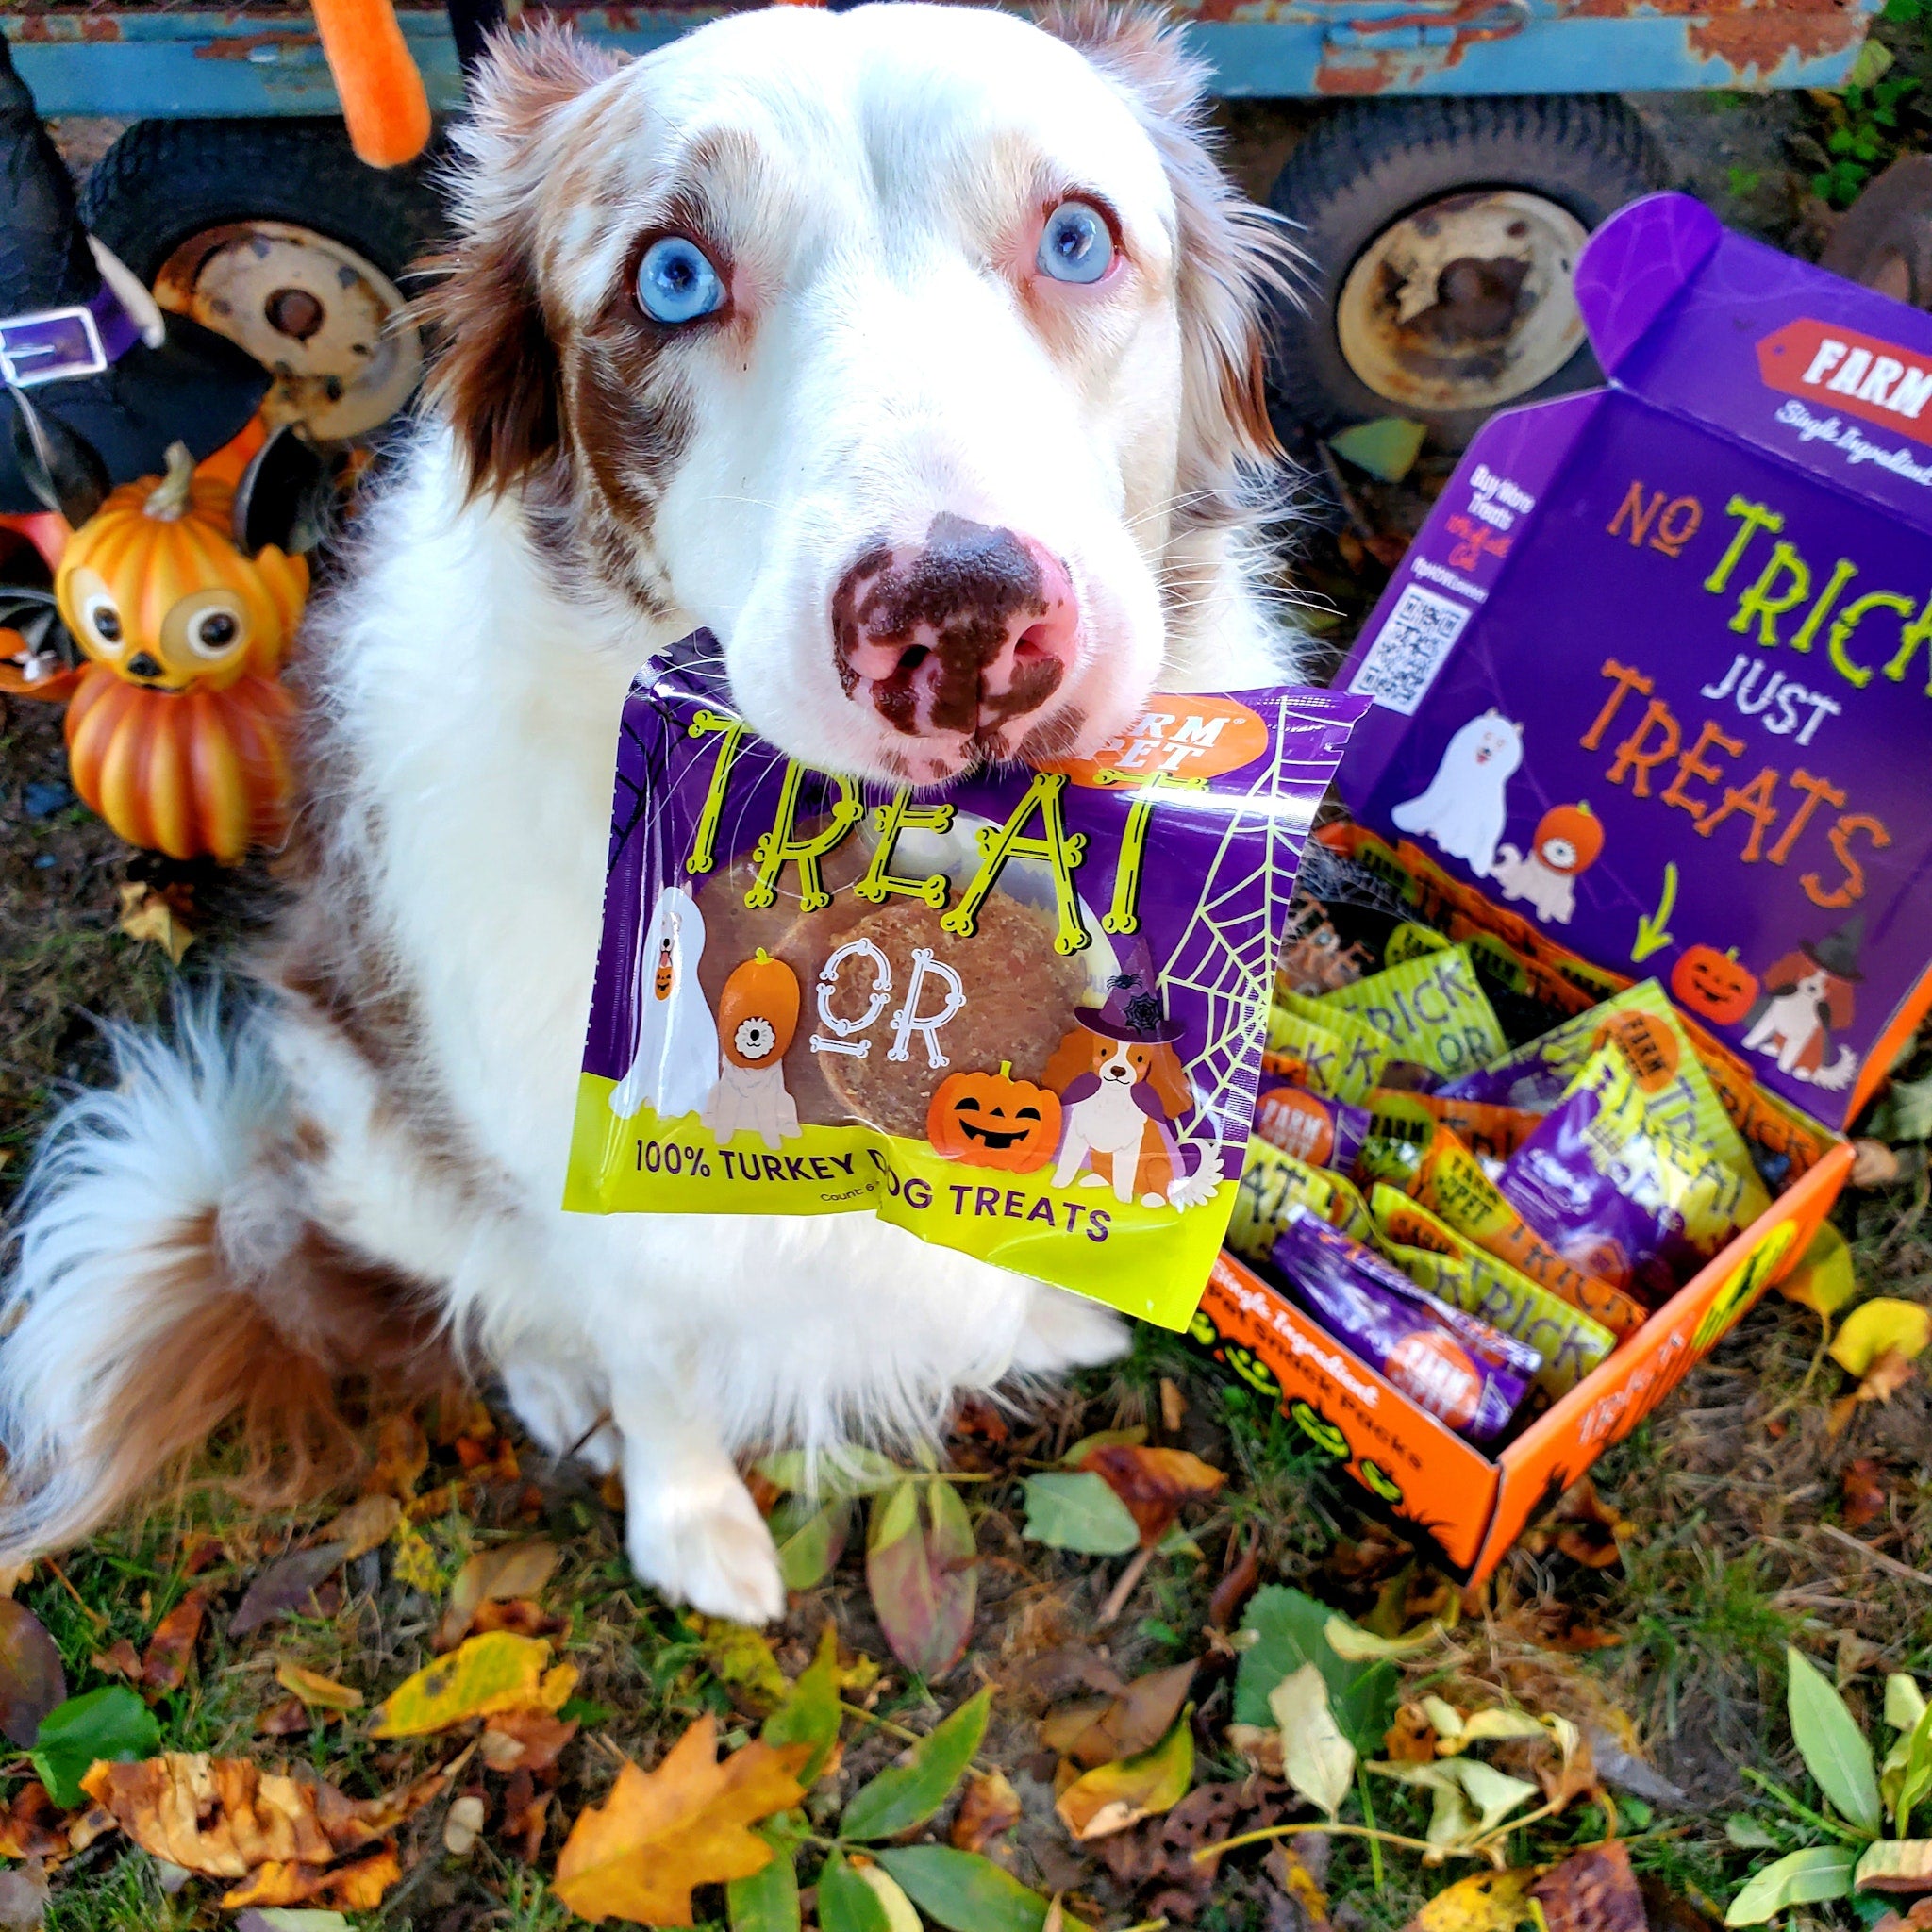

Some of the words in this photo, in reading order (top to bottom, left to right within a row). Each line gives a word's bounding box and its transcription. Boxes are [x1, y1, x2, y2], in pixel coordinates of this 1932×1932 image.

[1771, 399, 1841, 442] Single
[1801, 338, 1932, 419] FARM
[1469, 463, 1502, 501] Buy
[1606, 480, 1703, 558] NO
[1129, 712, 1231, 748] RM
[1701, 654, 1842, 747] JUST
[1579, 658, 1892, 908] TREATS
[687, 708, 1211, 957] TREAT
[809, 937, 967, 1069] OR
[1343, 959, 1478, 1045] RICK
[1436, 1026, 1496, 1072] OR
[636, 1139, 711, 1178] 100%
[718, 1148, 855, 1182] TURKEY
[949, 1184, 1112, 1243] TREATS
[1253, 1322, 1333, 1392] Snack
[1340, 1392, 1423, 1470] Packs
[1273, 1308, 1380, 1408] Ingredient
